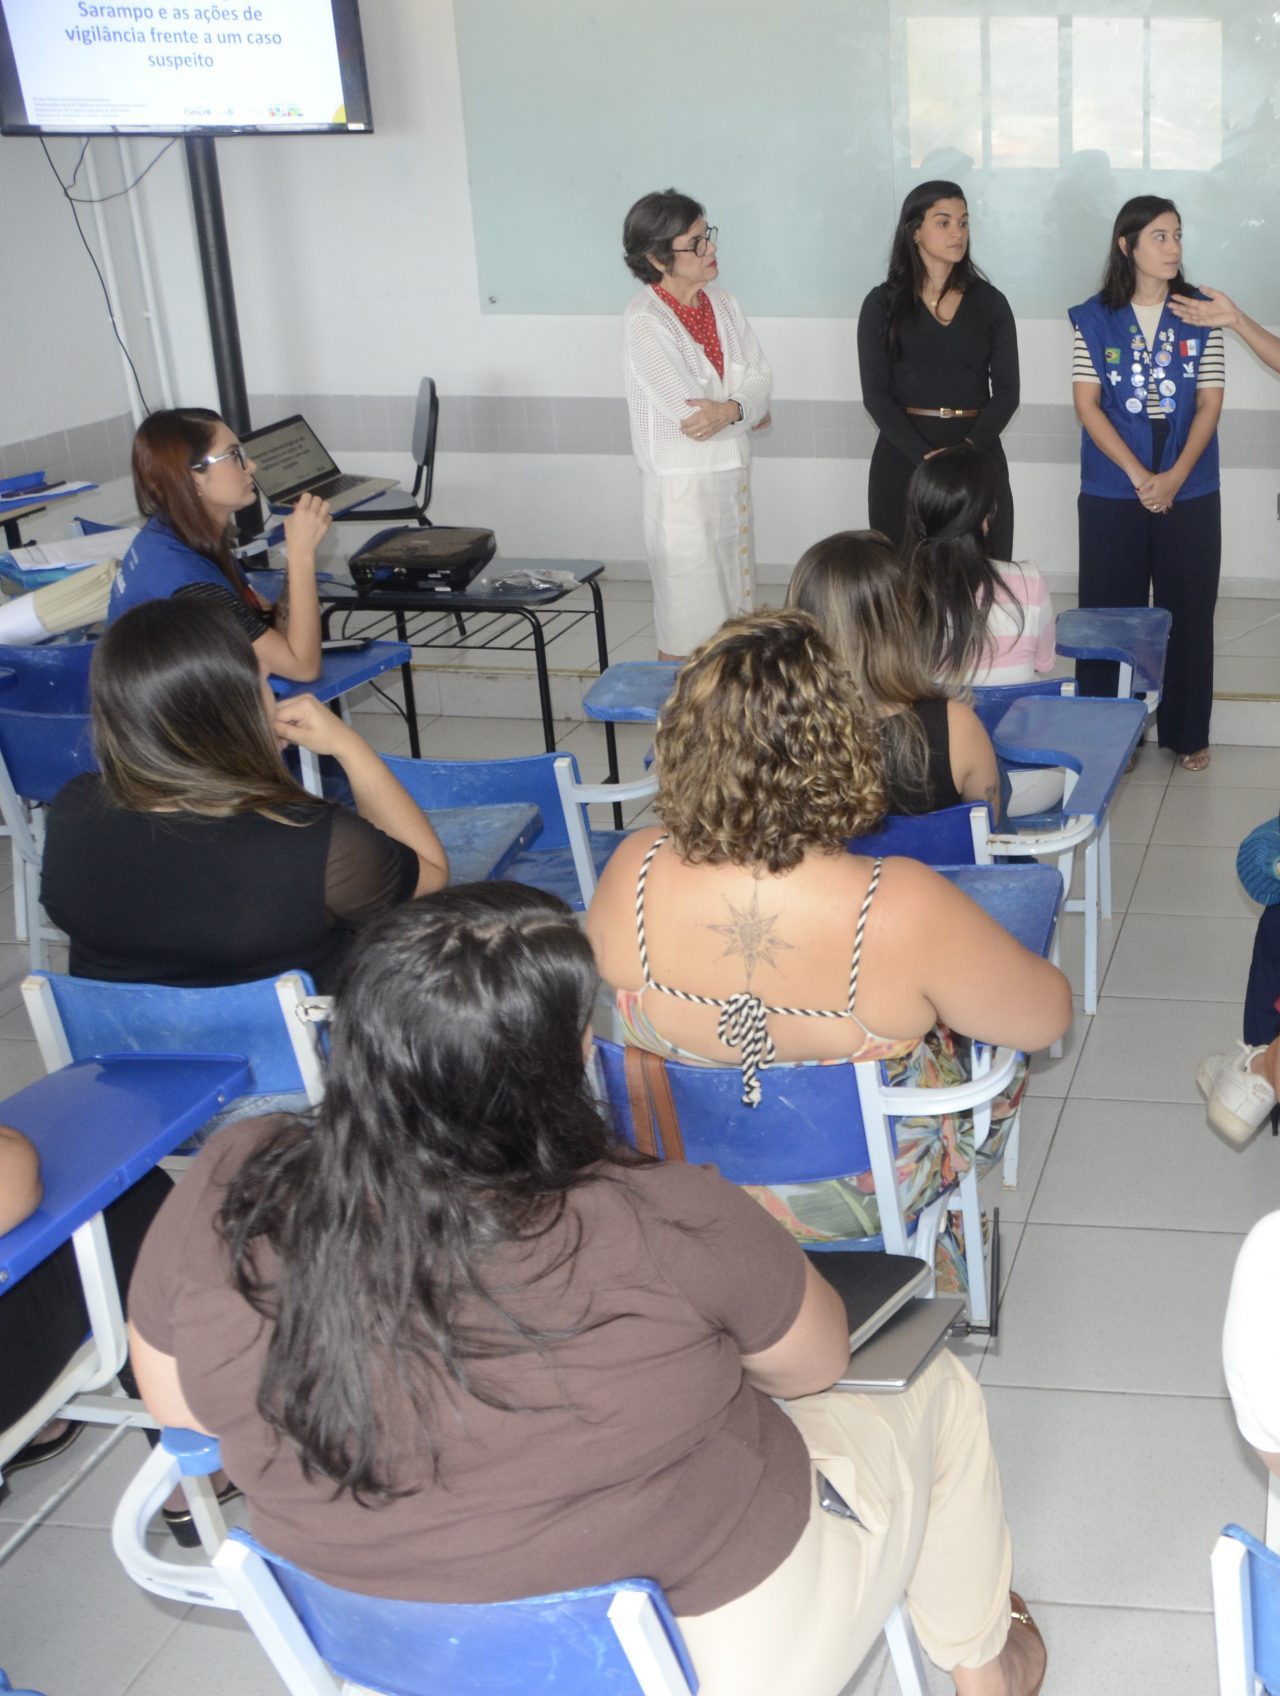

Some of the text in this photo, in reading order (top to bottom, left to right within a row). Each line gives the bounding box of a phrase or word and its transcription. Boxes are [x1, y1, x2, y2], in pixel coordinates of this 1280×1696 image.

[78, 1, 263, 24] Sarampo e as ações de
[65, 25, 282, 45] vigilância frente a um caso
[148, 52, 214, 70] suspeito
